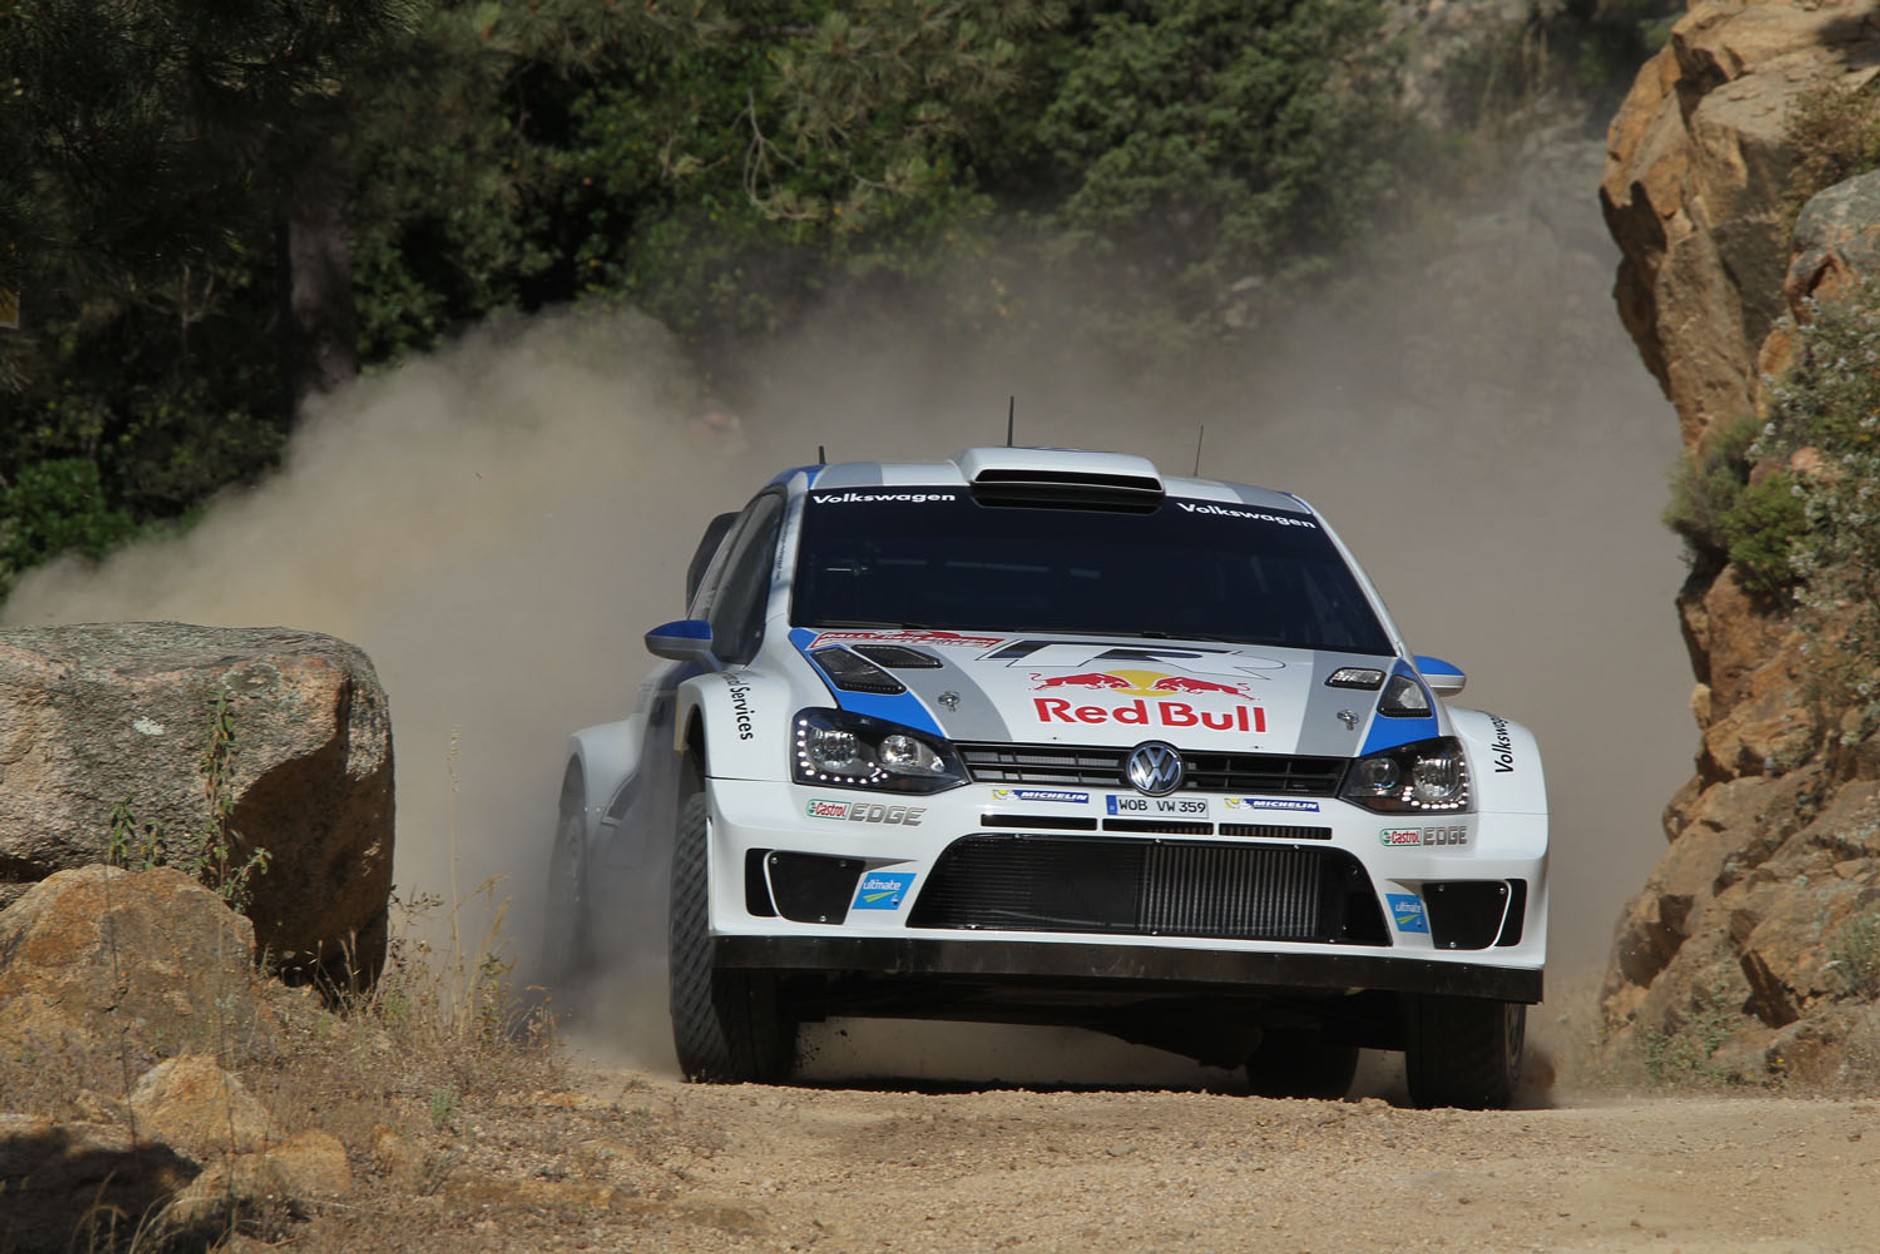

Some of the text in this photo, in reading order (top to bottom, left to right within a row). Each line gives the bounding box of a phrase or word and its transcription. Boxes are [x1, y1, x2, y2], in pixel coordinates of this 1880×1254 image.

[812, 493, 956, 503] Volkswagen
[1176, 502, 1317, 528] Volkswagen
[730, 687, 755, 740] Services
[1033, 698, 1266, 733] Red Bull
[1021, 792, 1088, 800] MICHELIN
[1119, 799, 1206, 813] WOB VW 359
[1253, 801, 1318, 809] MICHELIN
[815, 802, 927, 826] Castrol EDGE
[1391, 826, 1467, 846] Castrol EDGE
[863, 880, 901, 890] ultimate
